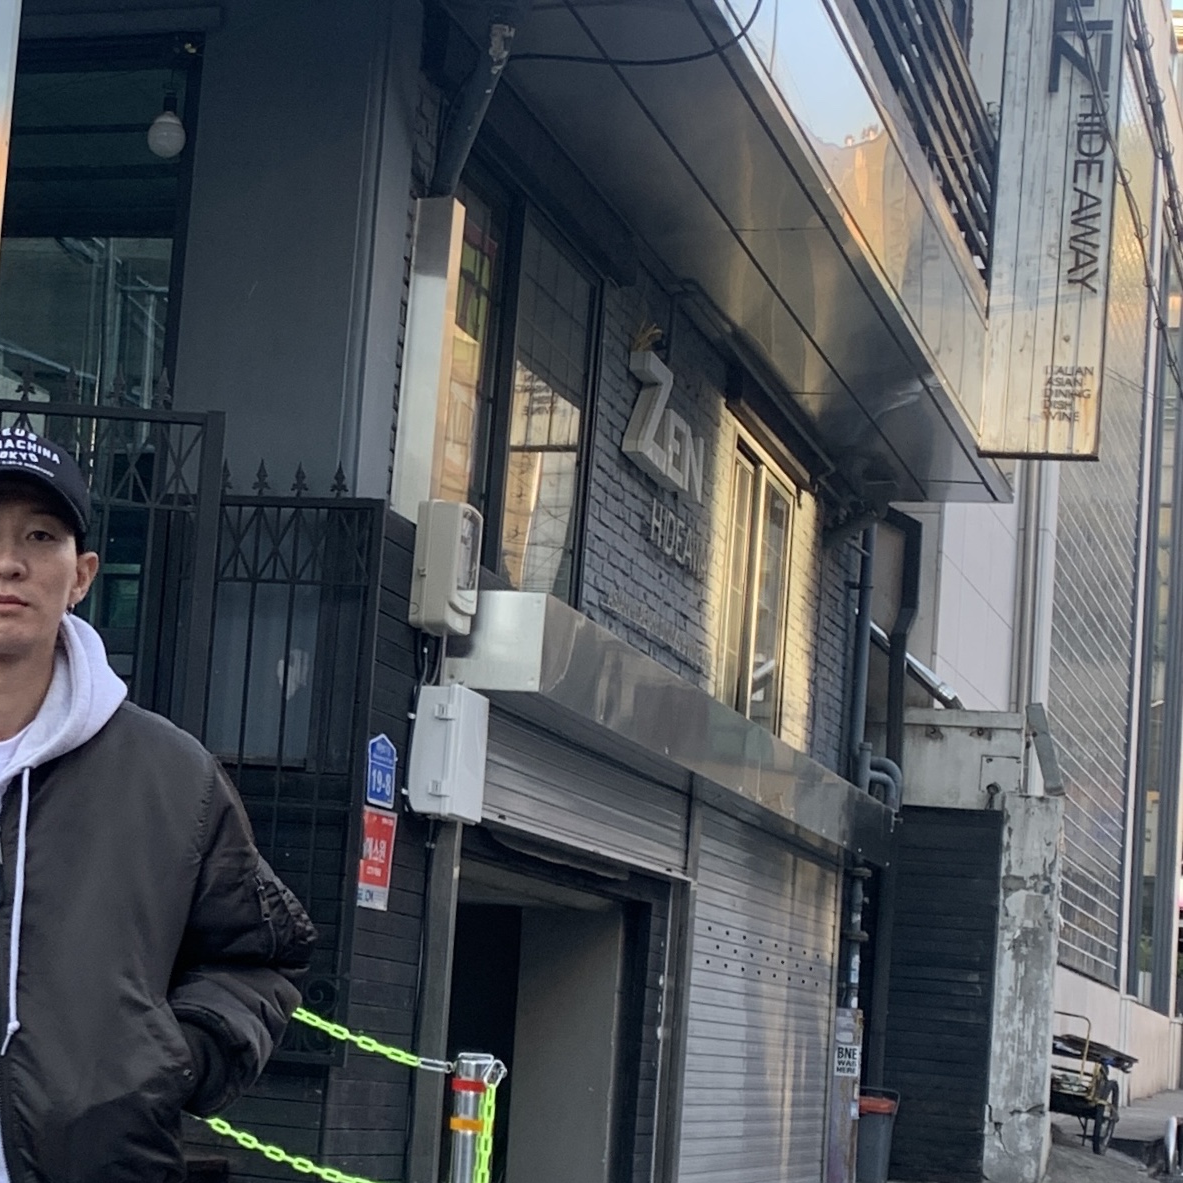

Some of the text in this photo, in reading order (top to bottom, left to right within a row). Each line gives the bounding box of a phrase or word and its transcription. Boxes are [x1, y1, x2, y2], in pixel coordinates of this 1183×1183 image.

[1067, 94, 1110, 294] HIDEAWAY
[1044, 365, 1095, 377] ITALIAN
[1045, 376, 1084, 388] ASIAN
[621, 350, 705, 504] ZEN
[650, 497, 708, 580] HIDEA
[372, 768, 392, 797] 19-8
[837, 1046, 858, 1060] BNE
